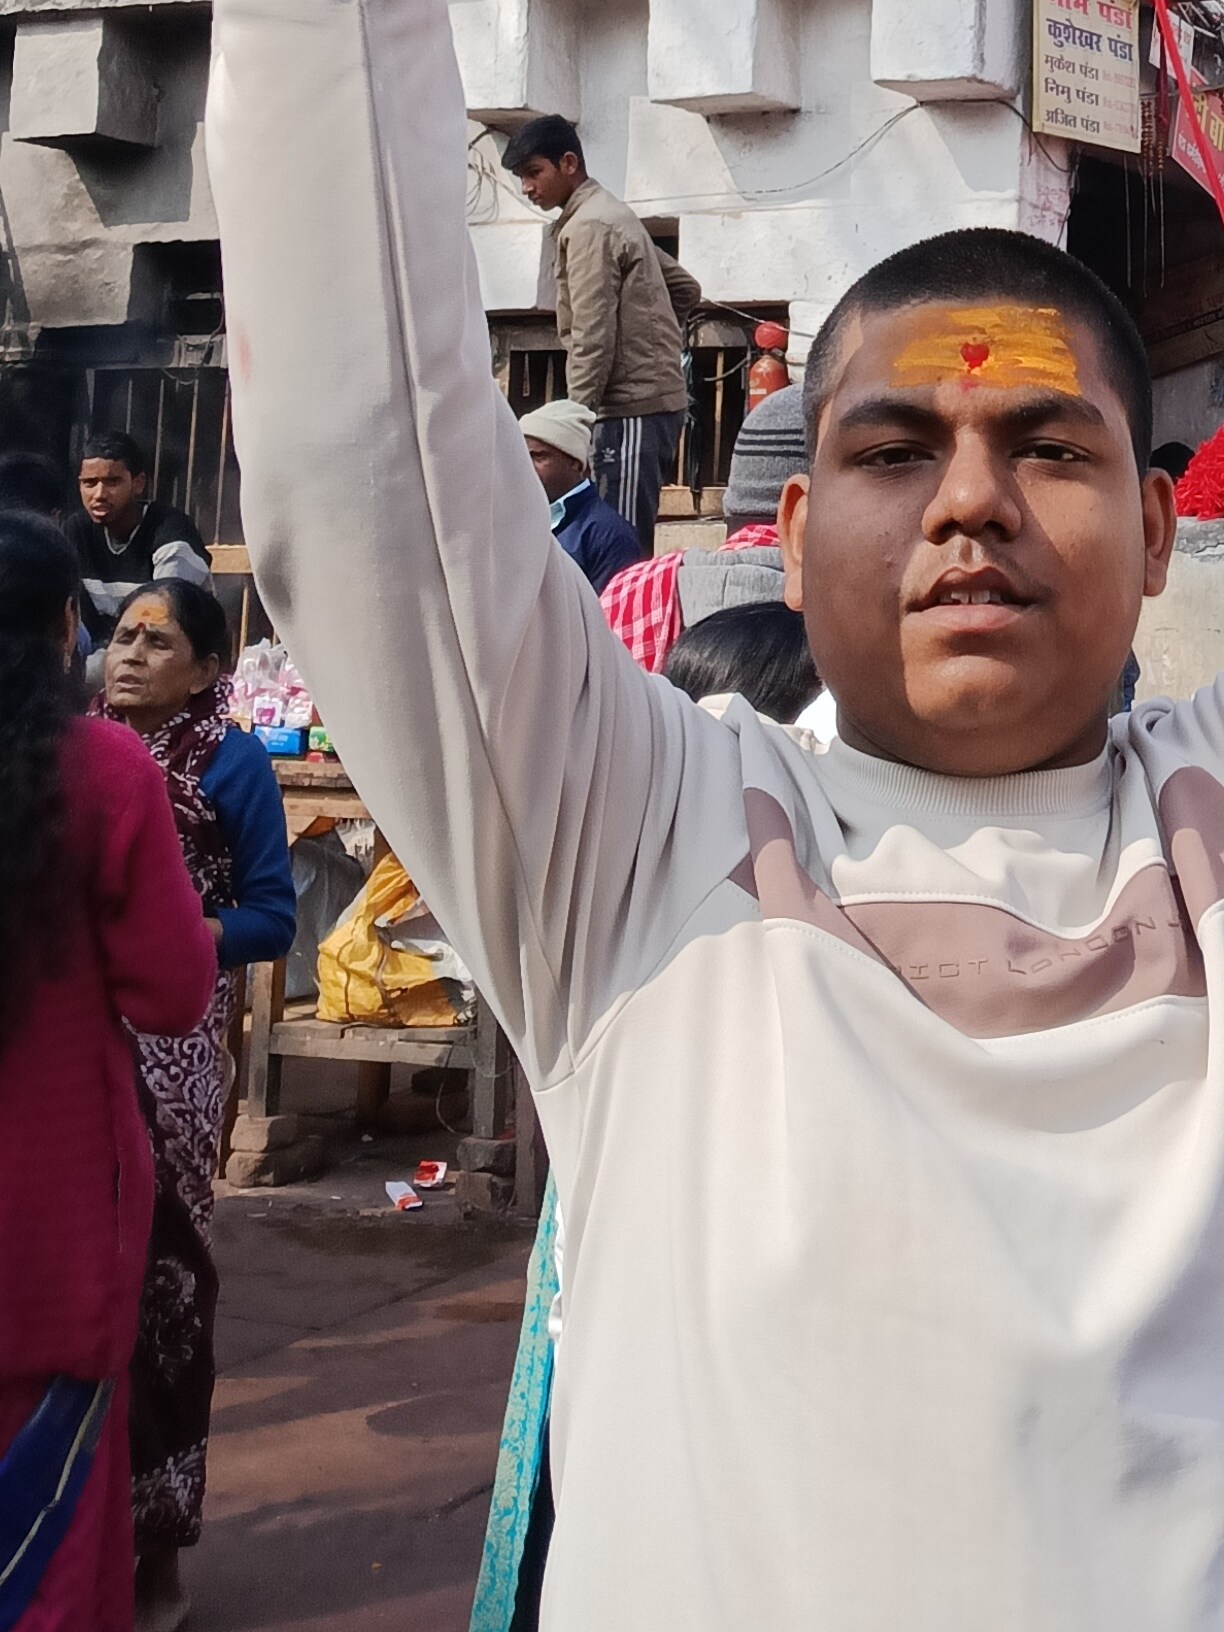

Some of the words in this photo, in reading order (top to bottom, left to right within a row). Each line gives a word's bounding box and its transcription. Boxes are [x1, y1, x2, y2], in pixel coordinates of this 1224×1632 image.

[1097, 0, 1133, 30] पंडा
[1107, 34, 1133, 61] पंडा
[1044, 54, 1076, 75] मुकेश
[1079, 62, 1099, 81] पंडा
[1075, 87, 1099, 106] पंडा
[1045, 108, 1077, 129] अजित
[1081, 115, 1100, 134] पंडा
[896, 958, 989, 980] ICT
[1007, 915, 1157, 975] LONDON
